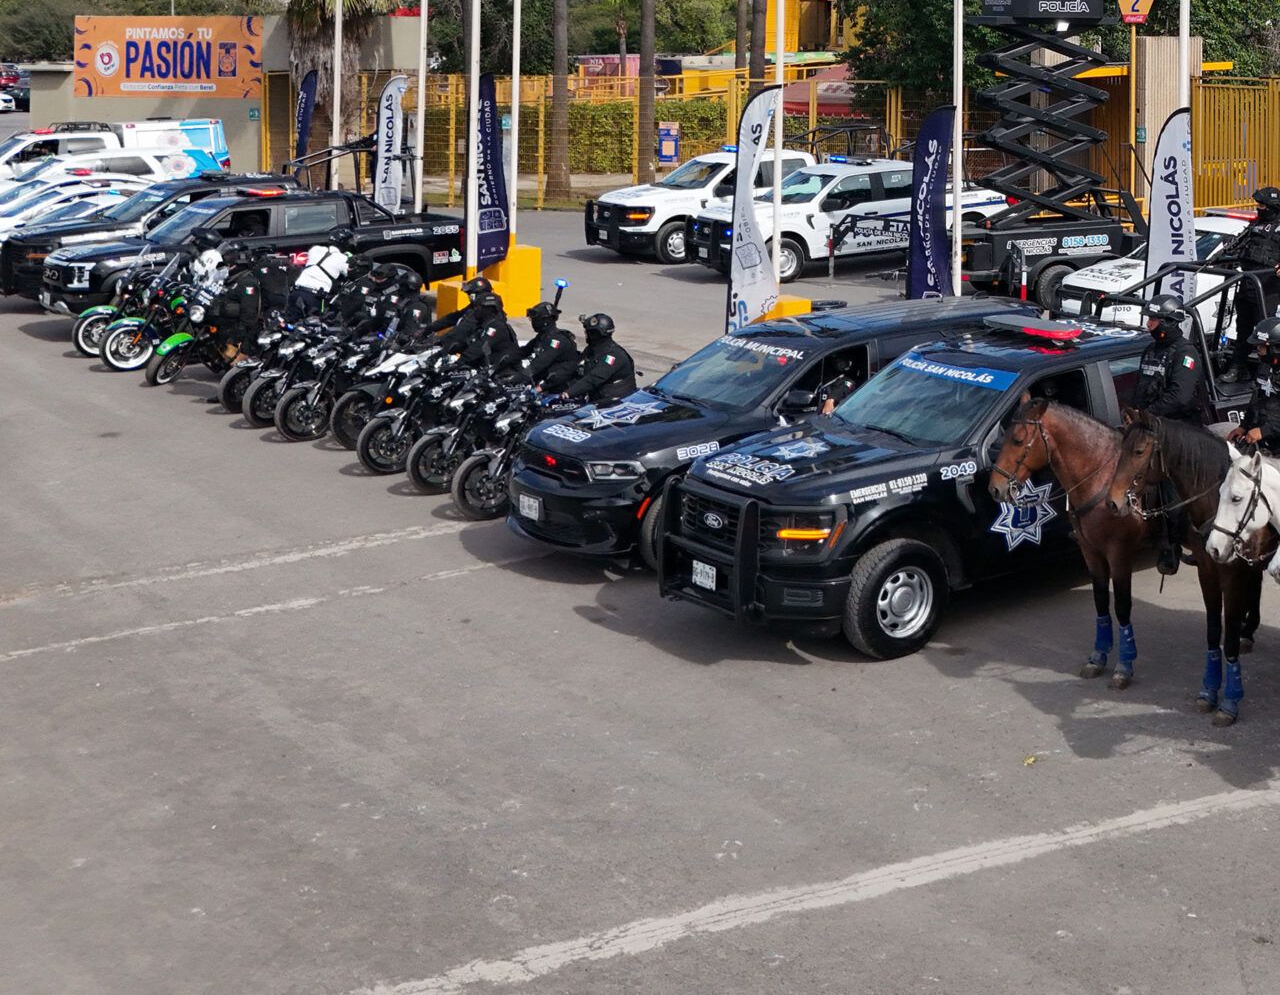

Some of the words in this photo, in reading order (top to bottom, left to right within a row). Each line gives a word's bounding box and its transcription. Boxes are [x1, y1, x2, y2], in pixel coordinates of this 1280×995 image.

[1039, 0, 1090, 12] POLICÍA
[125, 27, 185, 39] PINTAMOS
[196, 27, 212, 39] TU
[125, 32, 212, 79] PASIÓN
[148, 83, 174, 91] Confianza
[484, 100, 492, 133] CIUDAD
[1160, 155, 1185, 255] NICOLÁS
[432, 225, 460, 235] 2055
[744, 341, 805, 360] MUNICIPAL
[924, 364, 947, 375] SAN
[943, 368, 995, 384] NICOLÁS
[543, 424, 592, 443] 3028
[676, 440, 720, 461] 3028
[712, 453, 796, 481] POLICÍA
[940, 461, 977, 481] 2049
[849, 483, 887, 499] EMERGENCIAS
[853, 496, 865, 505] SAN
